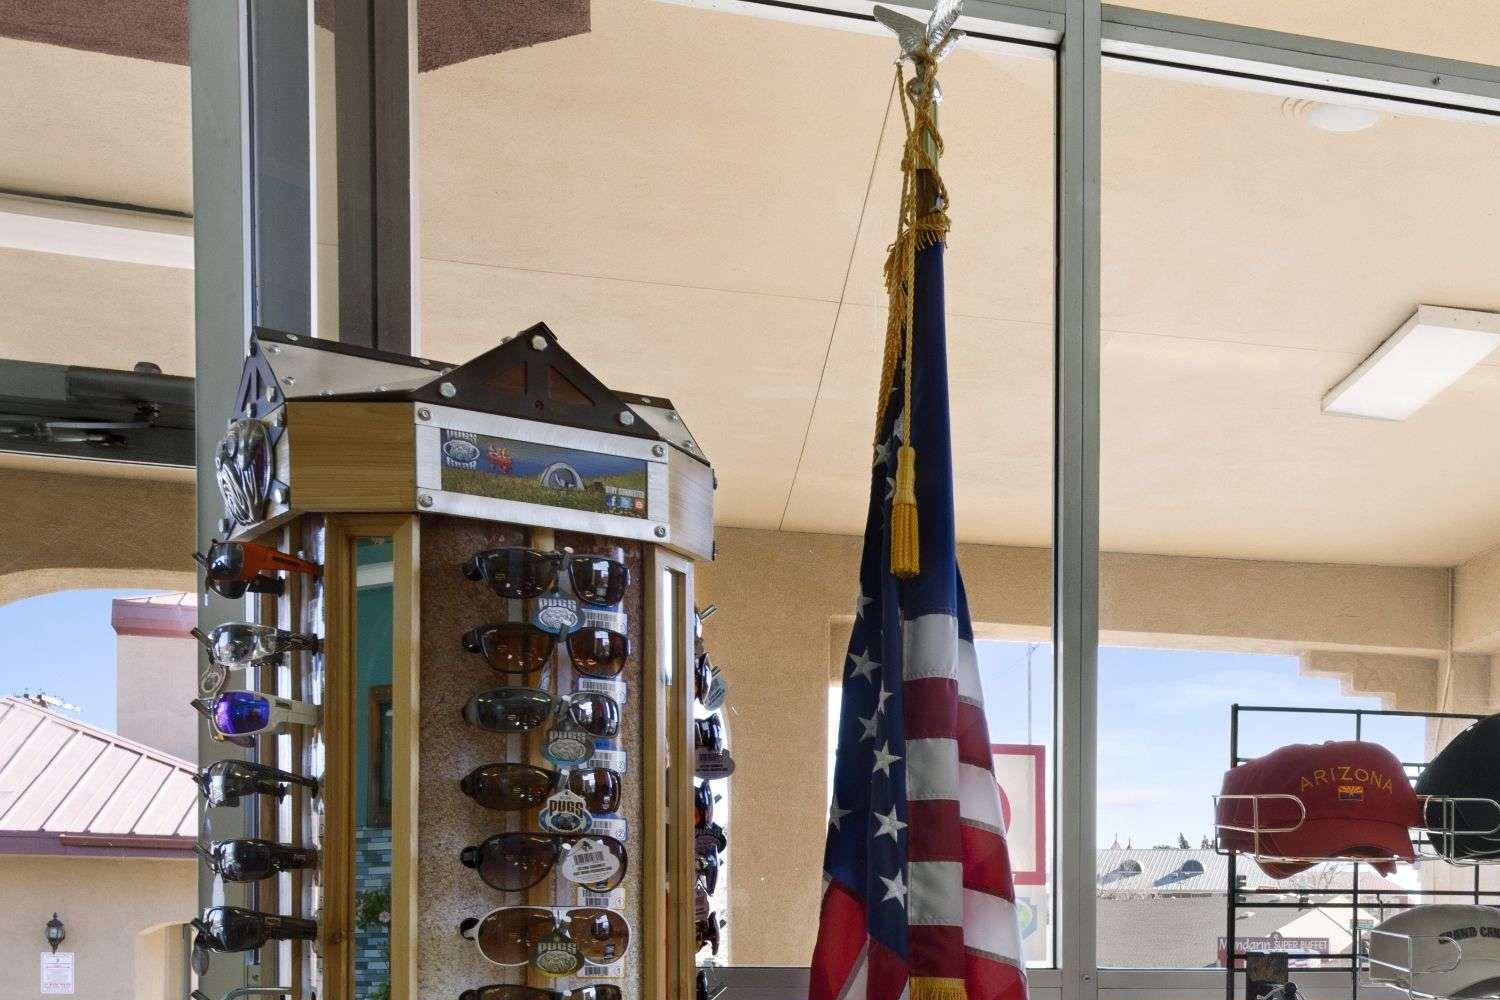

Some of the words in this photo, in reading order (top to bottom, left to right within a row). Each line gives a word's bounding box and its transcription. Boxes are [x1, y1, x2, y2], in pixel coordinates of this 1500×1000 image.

[1300, 766, 1393, 795] ARIZONA
[549, 800, 583, 819] PUGS
[1219, 938, 1271, 951] Mndarin
